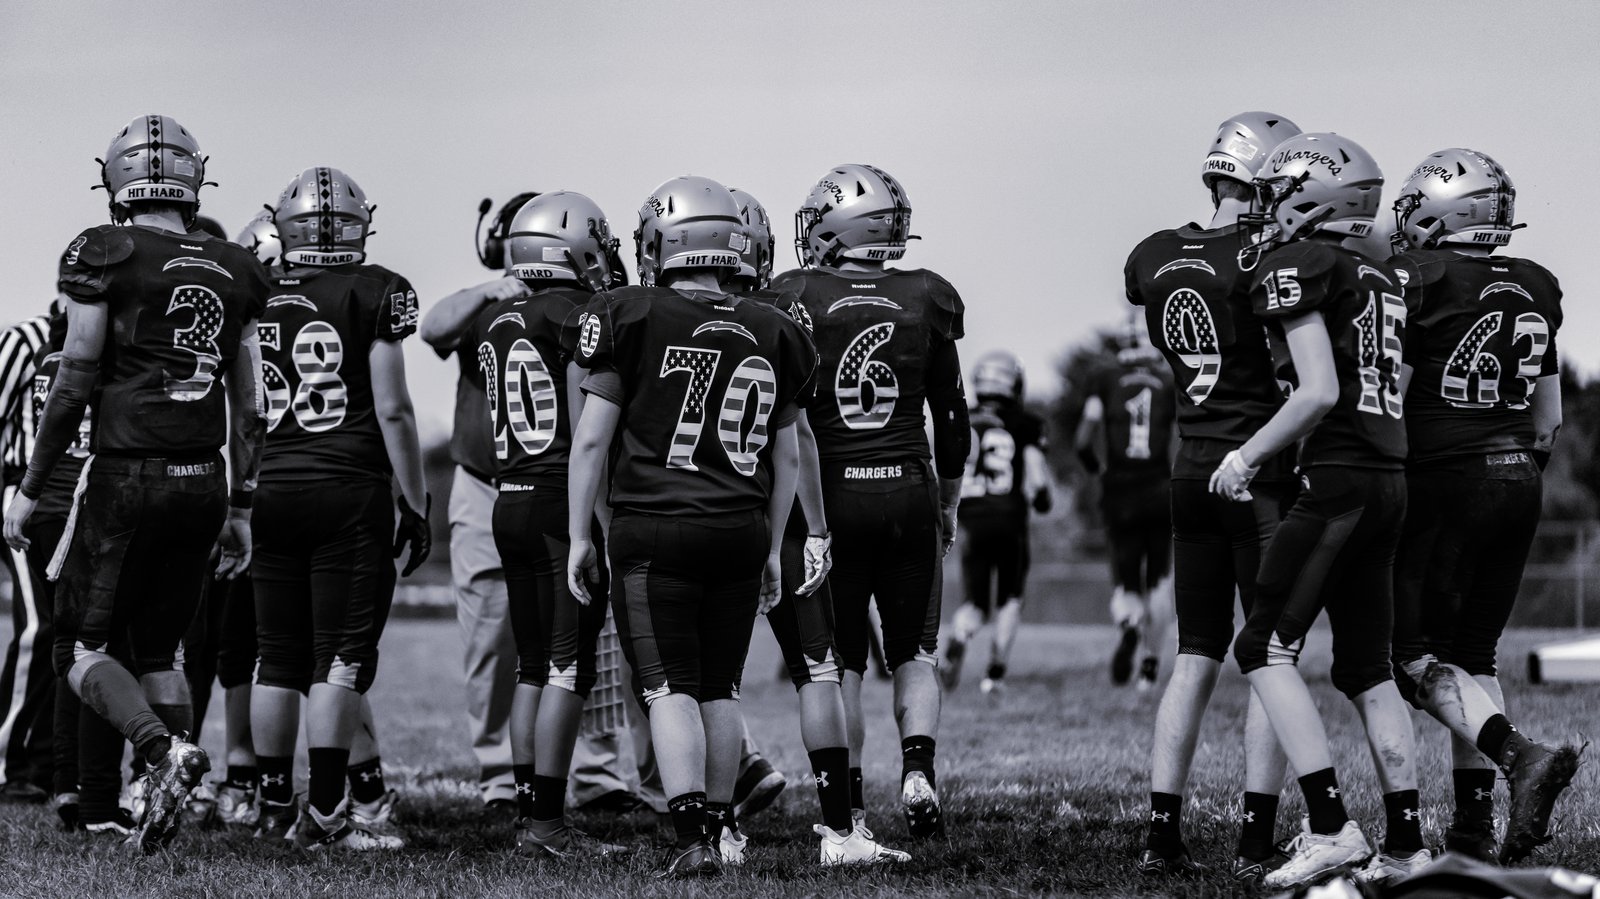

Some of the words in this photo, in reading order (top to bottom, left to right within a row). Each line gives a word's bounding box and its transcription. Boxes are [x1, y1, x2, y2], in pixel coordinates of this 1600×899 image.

[1208, 160, 1235, 172] HARD
[1272, 149, 1342, 176] Chargers
[128, 188, 146, 198] HIT
[150, 188, 185, 198] HARD
[1350, 222, 1368, 235] HIT
[1472, 232, 1493, 242] HIT
[66, 236, 87, 265] 3
[300, 254, 318, 263] HIT
[321, 254, 354, 263] HARD
[686, 256, 709, 265] HIT
[711, 256, 738, 265] HARD
[867, 249, 886, 259] HIT
[522, 269, 553, 278] HARD
[1261, 267, 1302, 310] 15
[391, 290, 418, 333] 58
[162, 284, 224, 402] 3
[578, 312, 601, 357] 70
[1163, 287, 1222, 406] 9
[1352, 290, 1408, 420] 15
[258, 321, 348, 433] 58
[835, 322, 900, 430] 6
[1441, 311, 1549, 410] 63
[477, 338, 557, 460] 10
[659, 345, 777, 477] 70
[1125, 387, 1152, 460] 1
[844, 465, 902, 479] CHARGERS
